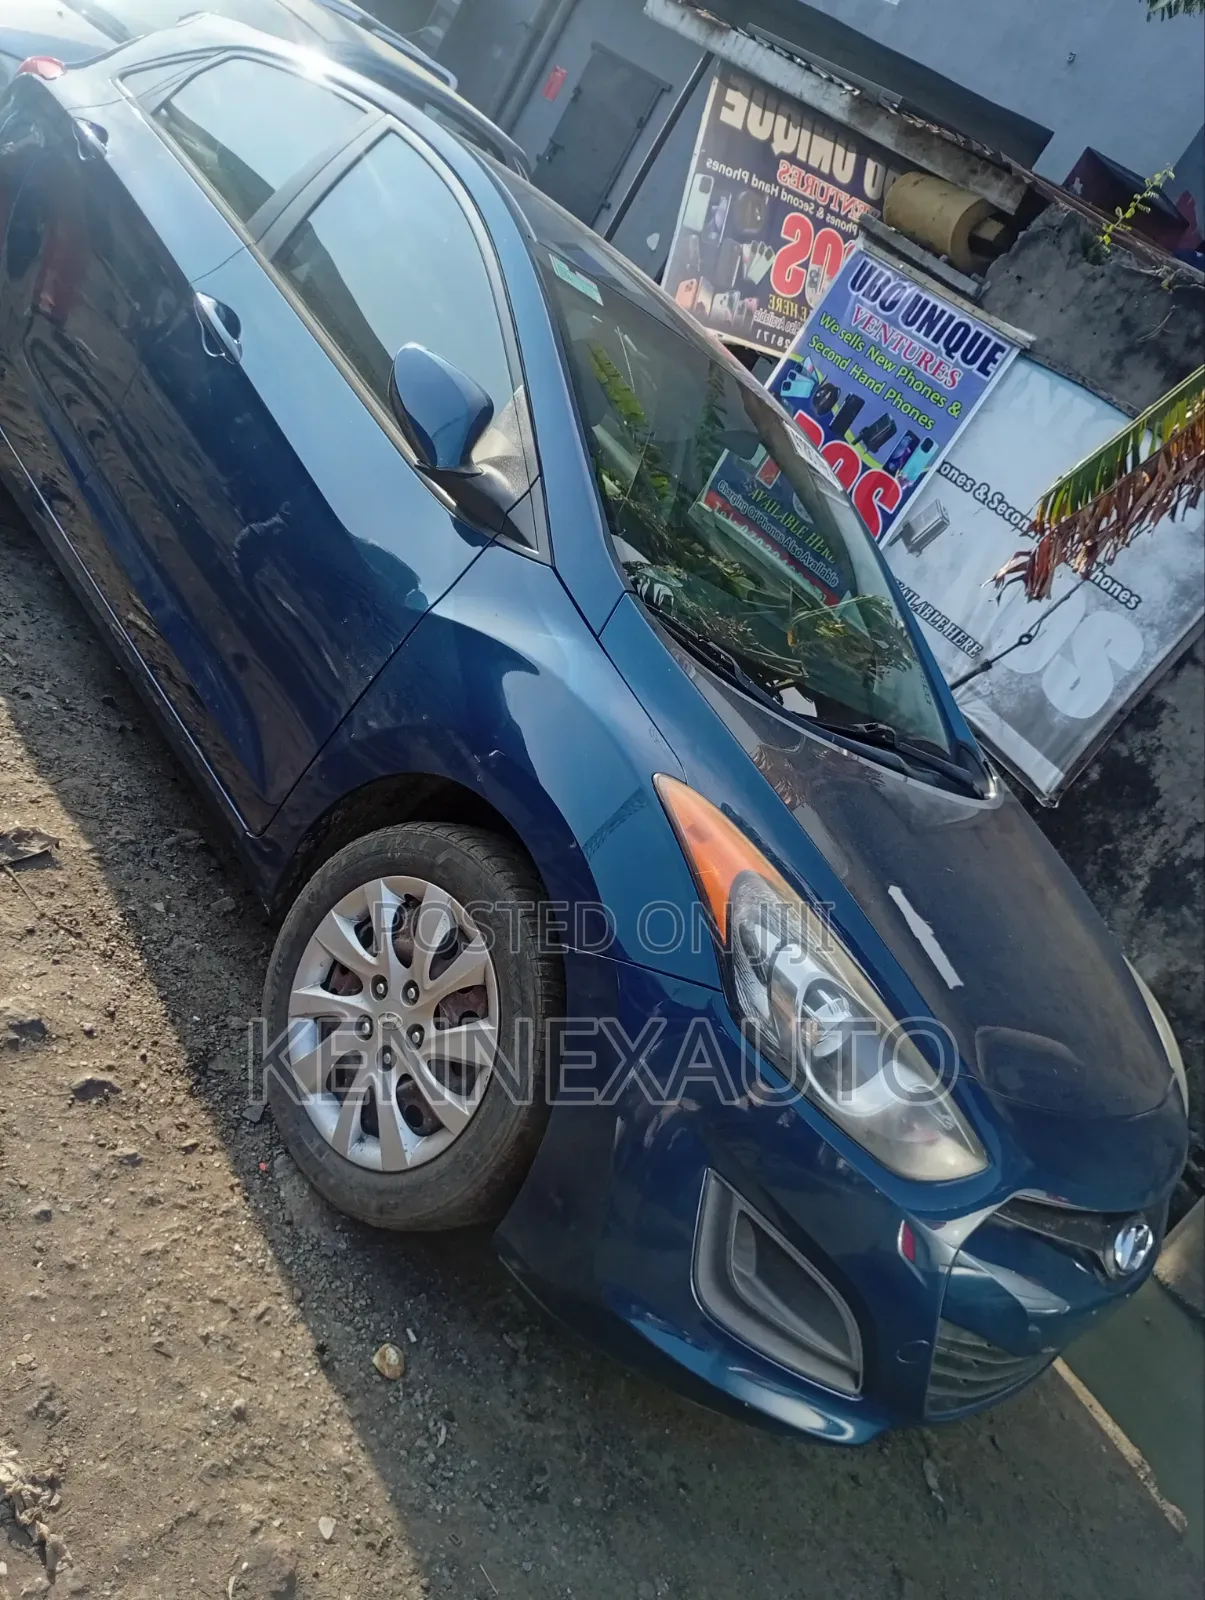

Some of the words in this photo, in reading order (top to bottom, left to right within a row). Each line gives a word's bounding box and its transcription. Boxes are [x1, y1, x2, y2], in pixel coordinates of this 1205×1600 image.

[808, 335, 848, 371] Second
[850, 361, 883, 395] Hand
[883, 386, 936, 431] Phones
[820, 312, 839, 334] We
[839, 325, 866, 352] sells
[865, 345, 897, 373] New
[897, 362, 948, 408] Phones
[947, 402, 963, 419] &
[851, 305, 963, 390] VENTURES
[900, 293, 1008, 379] UNIQUE
[718, 480, 753, 515] Charging
[756, 510, 785, 544] Phones
[784, 538, 803, 558] Also
[801, 551, 839, 587] Available
[939, 461, 976, 492] ones
[973, 482, 989, 507] &
[986, 492, 1042, 542] Secon
[1088, 562, 1142, 610] hones
[896, 578, 949, 634] AILABLE
[942, 621, 984, 659] HERE
